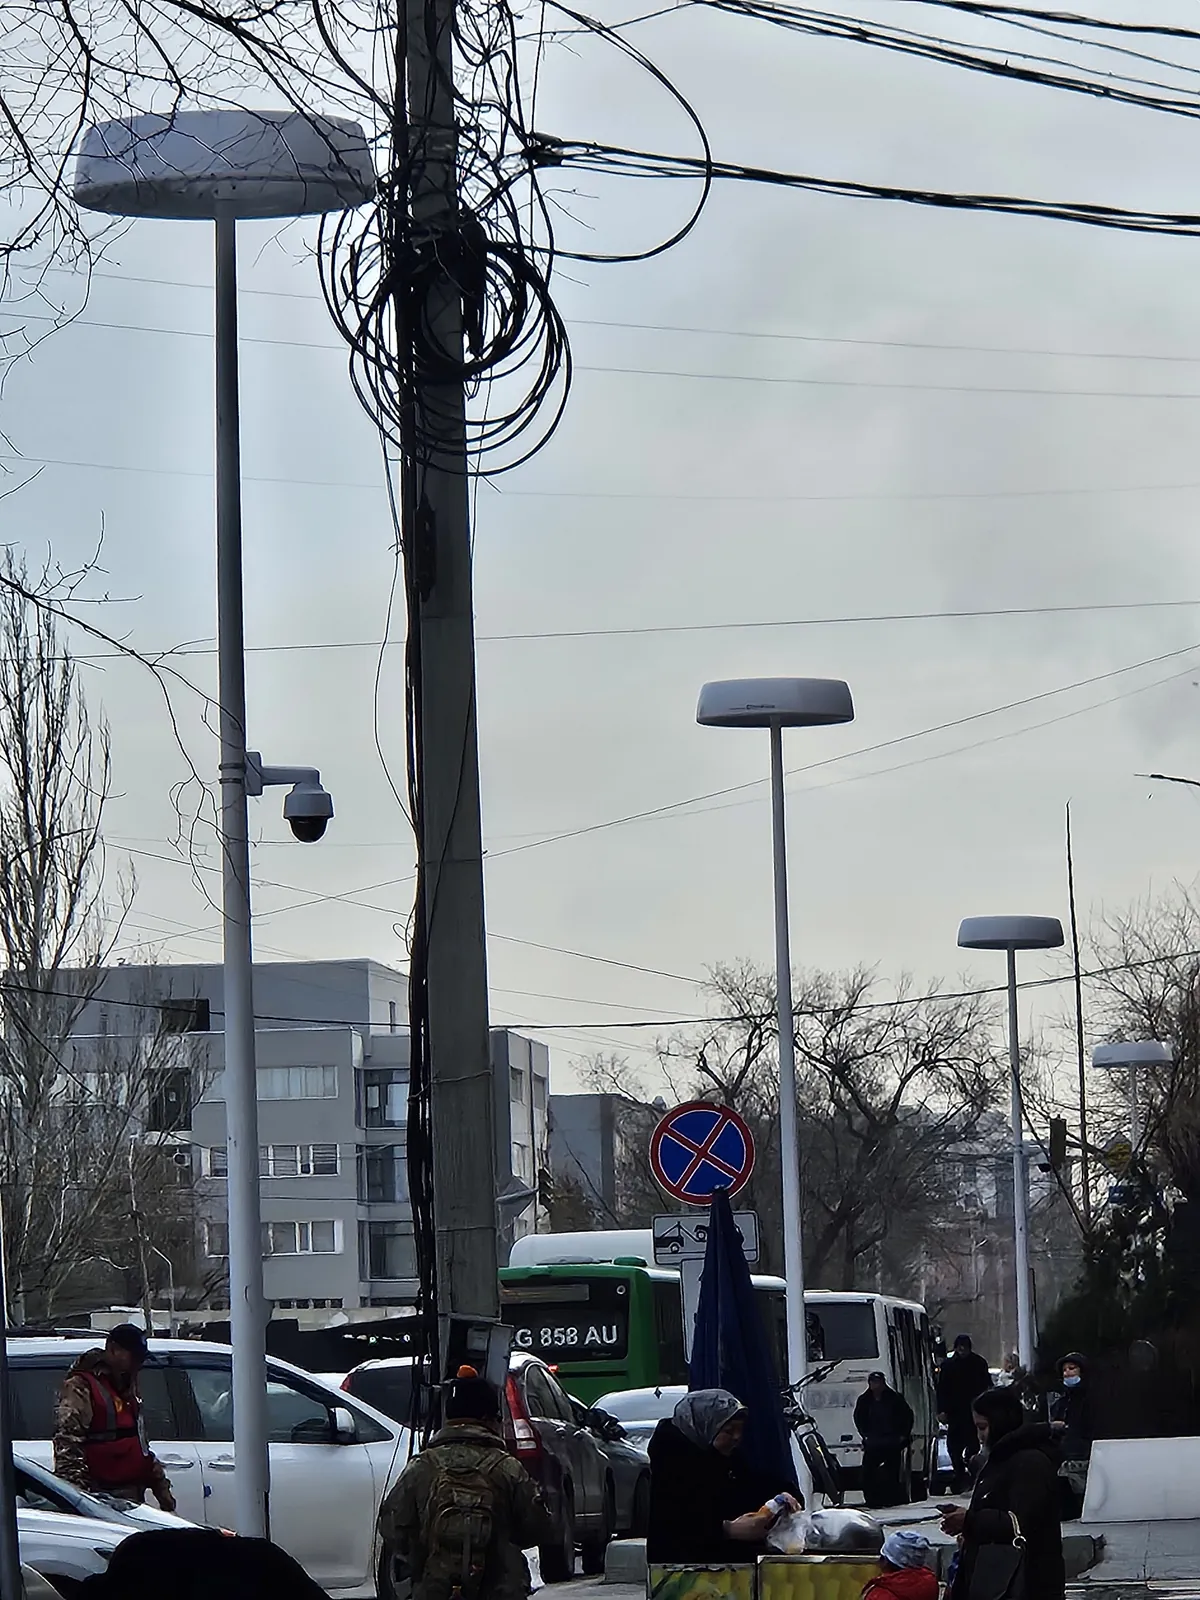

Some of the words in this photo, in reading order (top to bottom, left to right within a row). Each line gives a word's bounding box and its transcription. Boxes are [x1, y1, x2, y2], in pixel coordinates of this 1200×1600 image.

[510, 1328, 533, 1347] G
[540, 1327, 578, 1347] 858
[583, 1325, 617, 1345] AU
